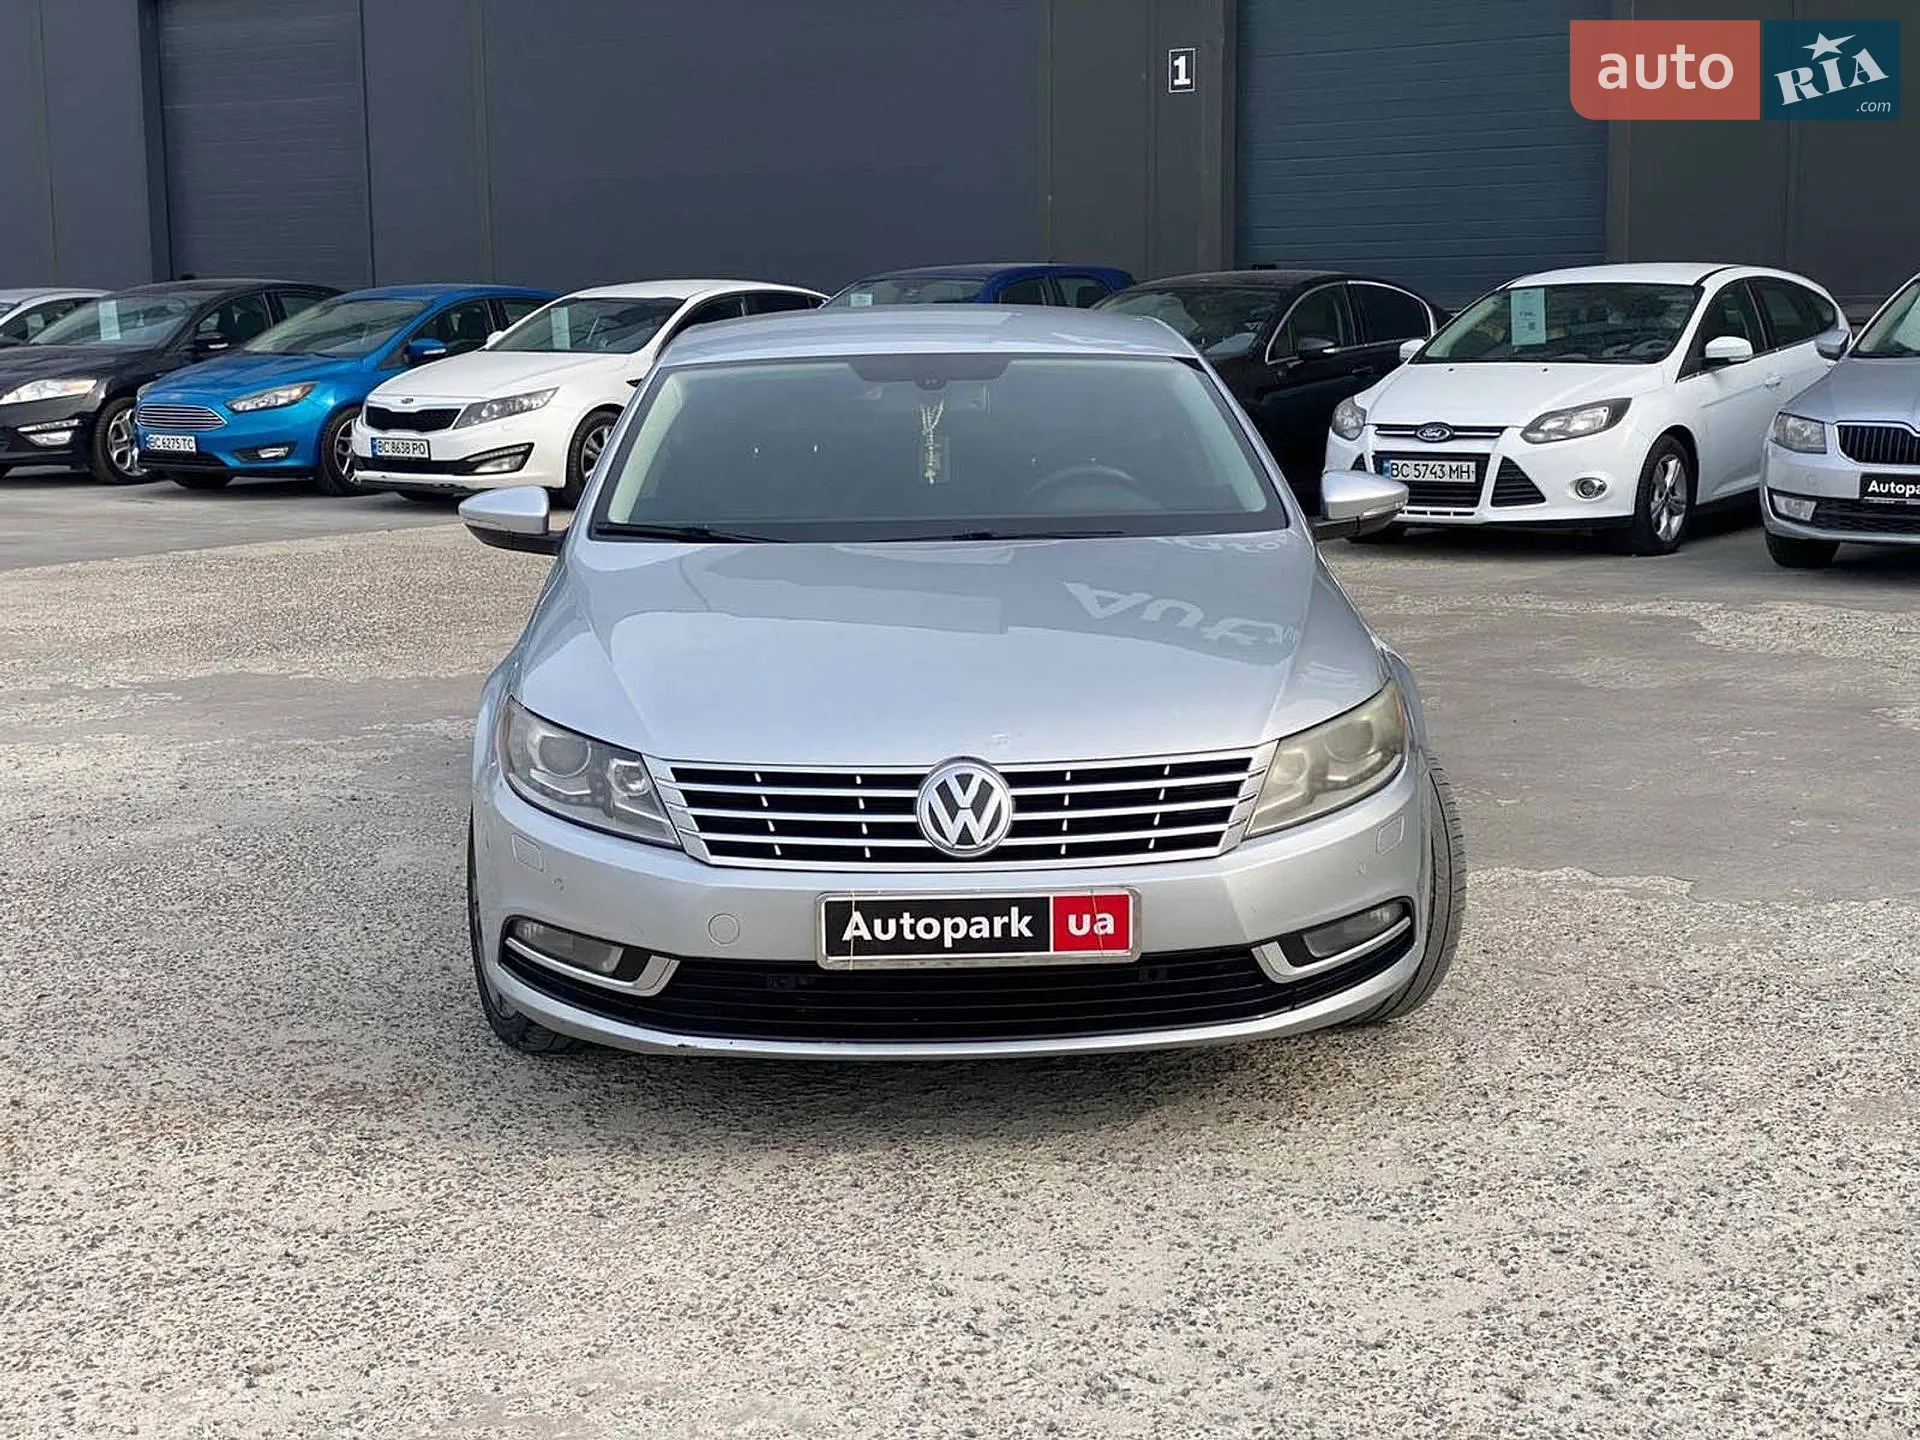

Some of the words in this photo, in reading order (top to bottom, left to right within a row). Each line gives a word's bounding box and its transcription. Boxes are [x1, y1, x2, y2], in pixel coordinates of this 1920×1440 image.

[1173, 55, 1192, 86] 1
[181, 438, 195, 450] TC
[378, 440, 390, 453] BC
[411, 442, 426, 455] PO
[1390, 463, 1410, 478] BC
[1413, 463, 1446, 479] 5743
[1448, 464, 1470, 480] MH
[841, 906, 1034, 949] Autopark
[1067, 911, 1116, 937] ua
